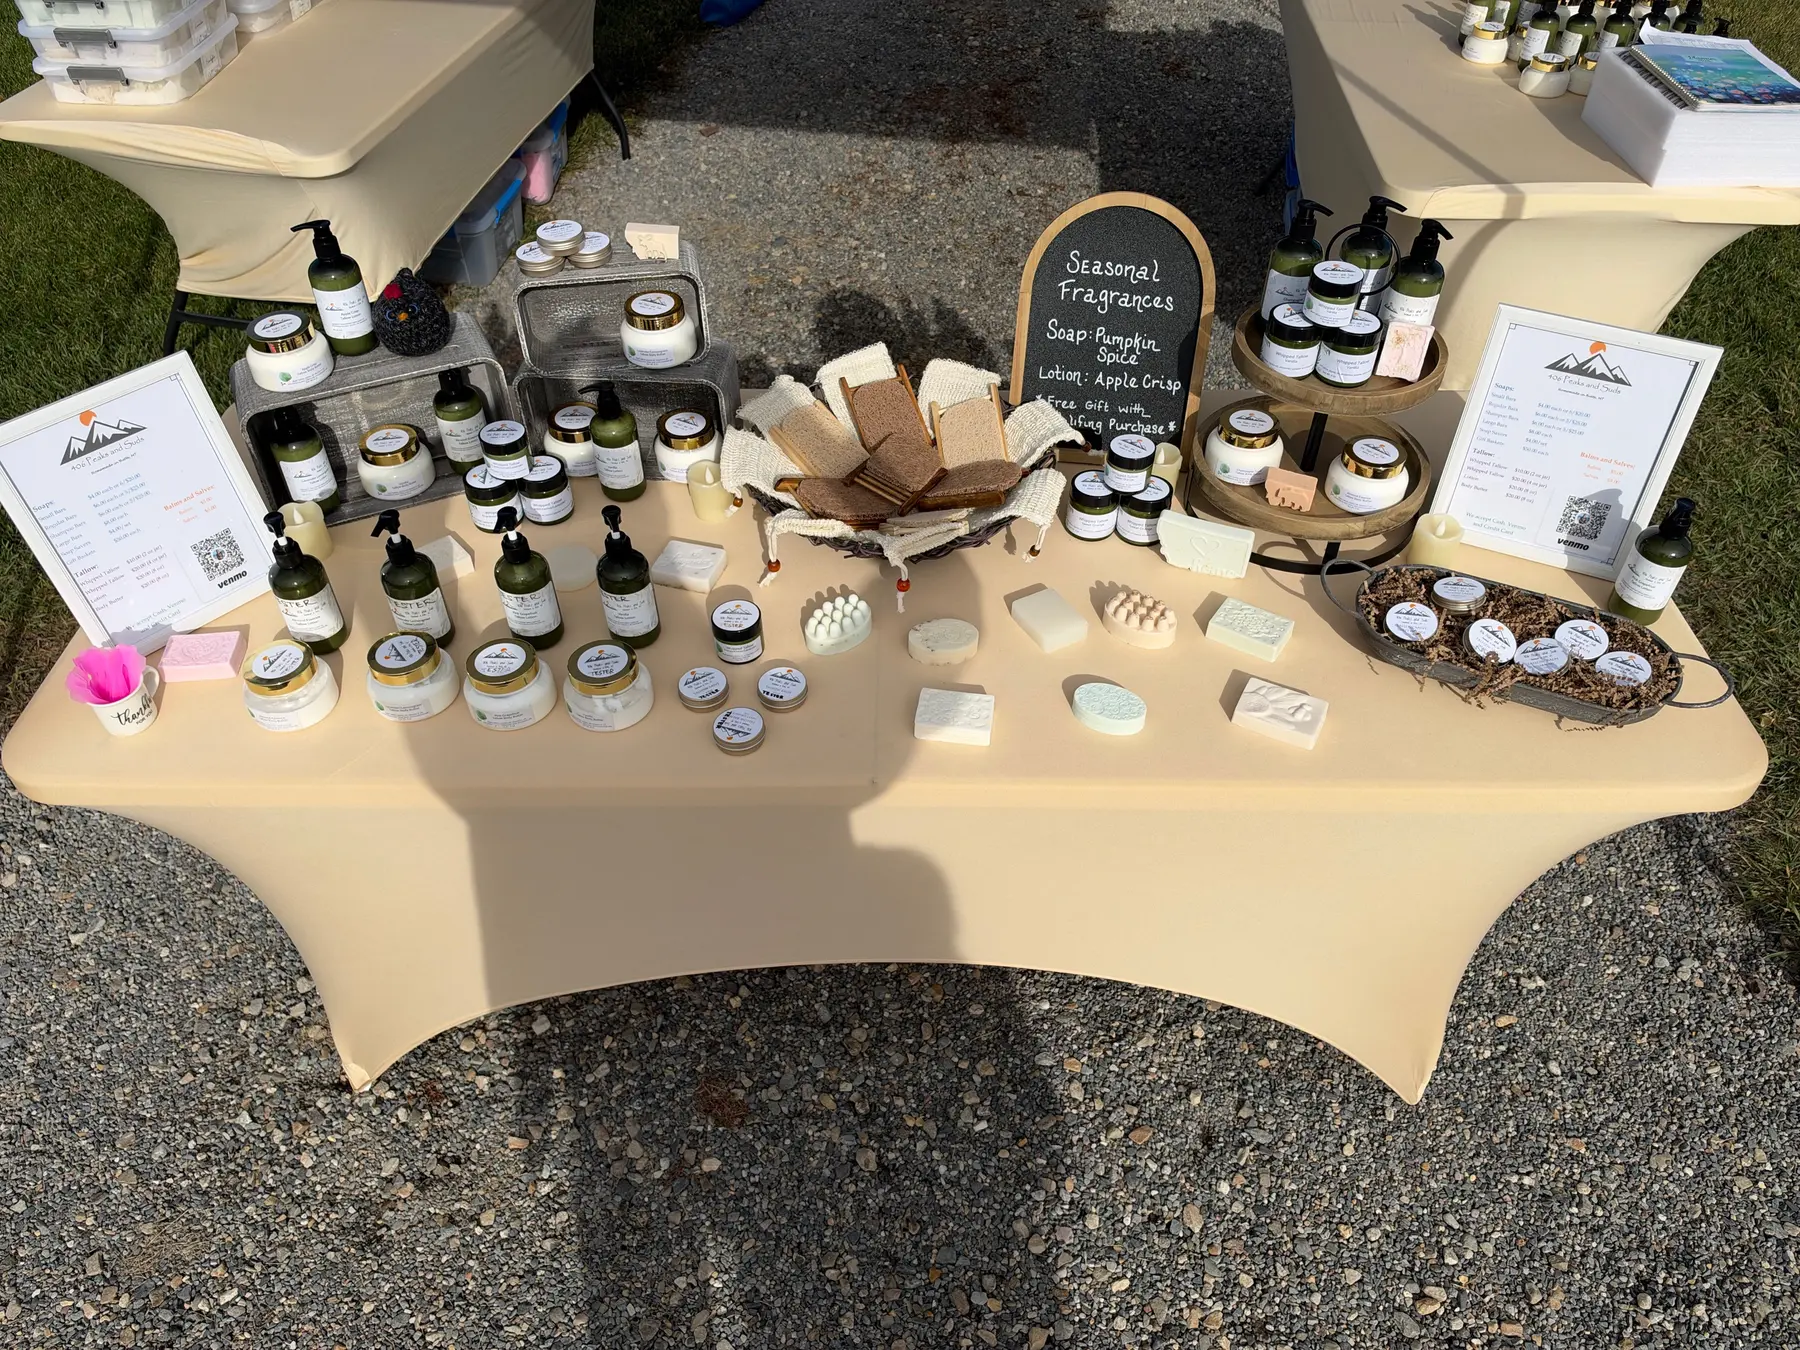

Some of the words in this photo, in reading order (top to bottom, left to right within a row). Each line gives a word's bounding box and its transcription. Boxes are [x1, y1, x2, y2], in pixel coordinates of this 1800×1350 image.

[1058, 279, 1174, 313] Fragrances
[1046, 318, 1092, 345] Soap:
[1095, 326, 1161, 355] Pumpkin
[1097, 346, 1139, 365] Spice
[1039, 364, 1089, 386] Lotion:
[1095, 371, 1139, 392] Apple
[1142, 373, 1182, 395] Crisp
[1494, 383, 1514, 391] Soaps:
[1548, 374, 1563, 382] 406
[1563, 374, 1585, 386] Peaks
[1599, 383, 1621, 394] Suds
[1085, 400, 1109, 412] Gift
[1118, 403, 1151, 418] with
[71, 460, 86, 471] 406
[85, 451, 109, 466] Peaks
[109, 442, 124, 455] and
[123, 435, 145, 450] Suds
[1473, 448, 1495, 457] Tallow:
[1580, 452, 1599, 461] Balms
[163, 500, 183, 511] Balms
[183, 493, 195, 503] and
[1557, 538, 1589, 551] venmo
[74, 564, 99, 578] Tallow:
[217, 570, 247, 589] venmo
[389, 597, 436, 609] ESTER
[501, 593, 542, 603] ESTER
[590, 668, 615, 677] TESTER
